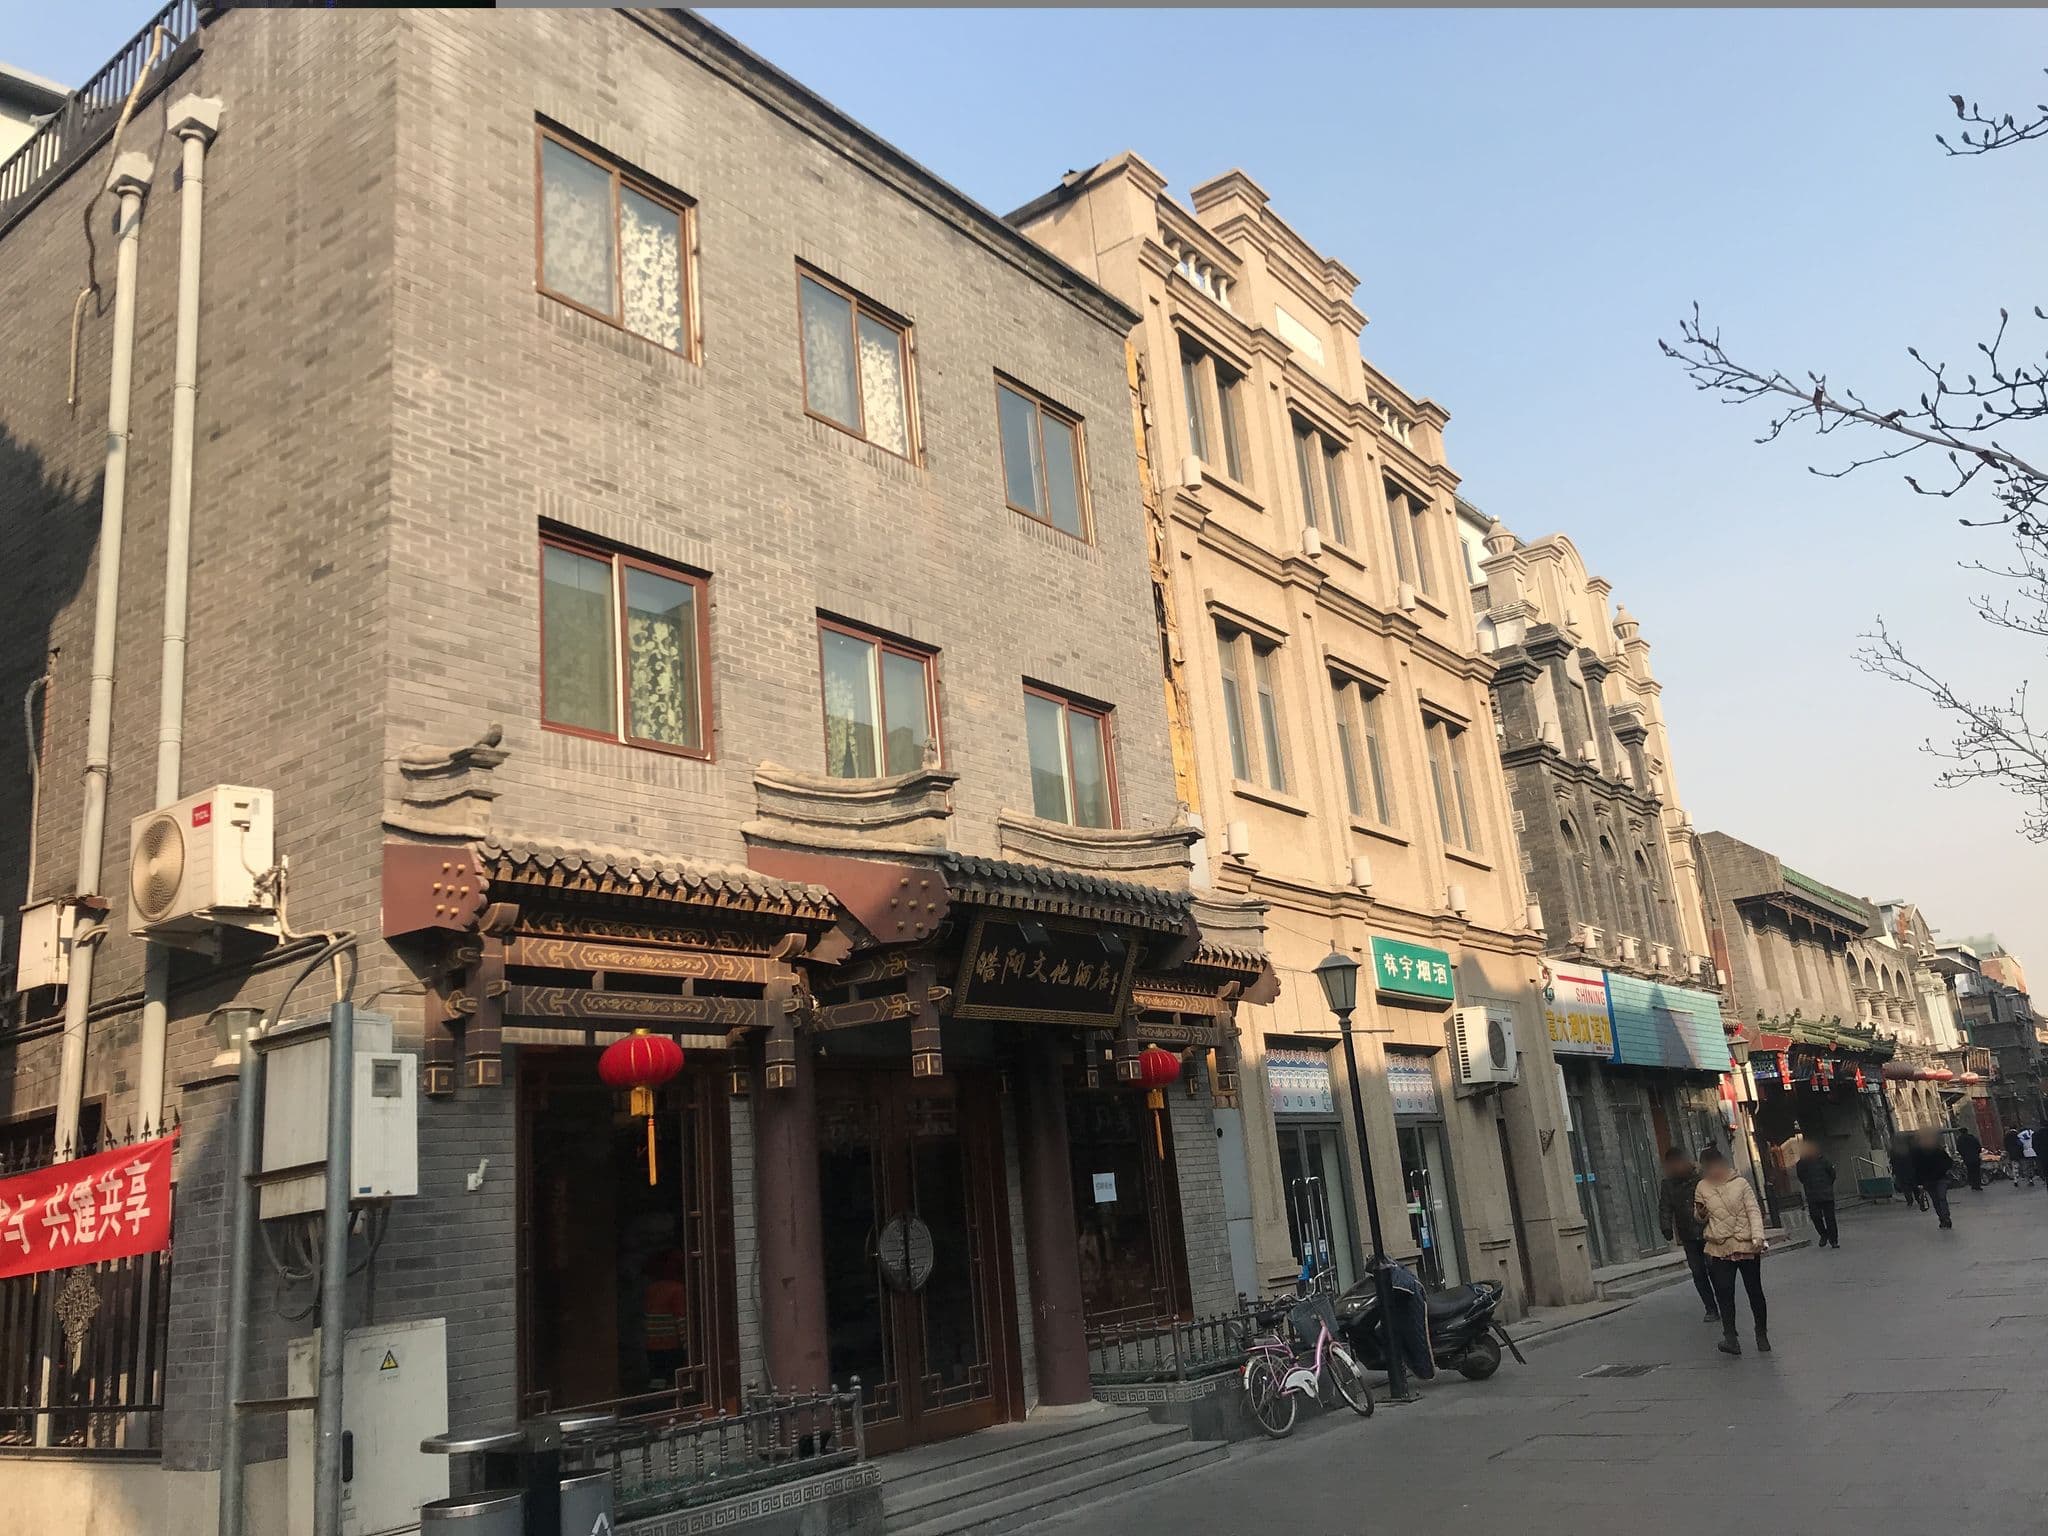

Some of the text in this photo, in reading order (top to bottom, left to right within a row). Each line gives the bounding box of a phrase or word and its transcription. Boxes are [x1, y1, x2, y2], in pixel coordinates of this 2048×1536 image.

[1383, 952, 1448, 985] 林宇烟酒
[1576, 988, 1606, 1005] SHINING
